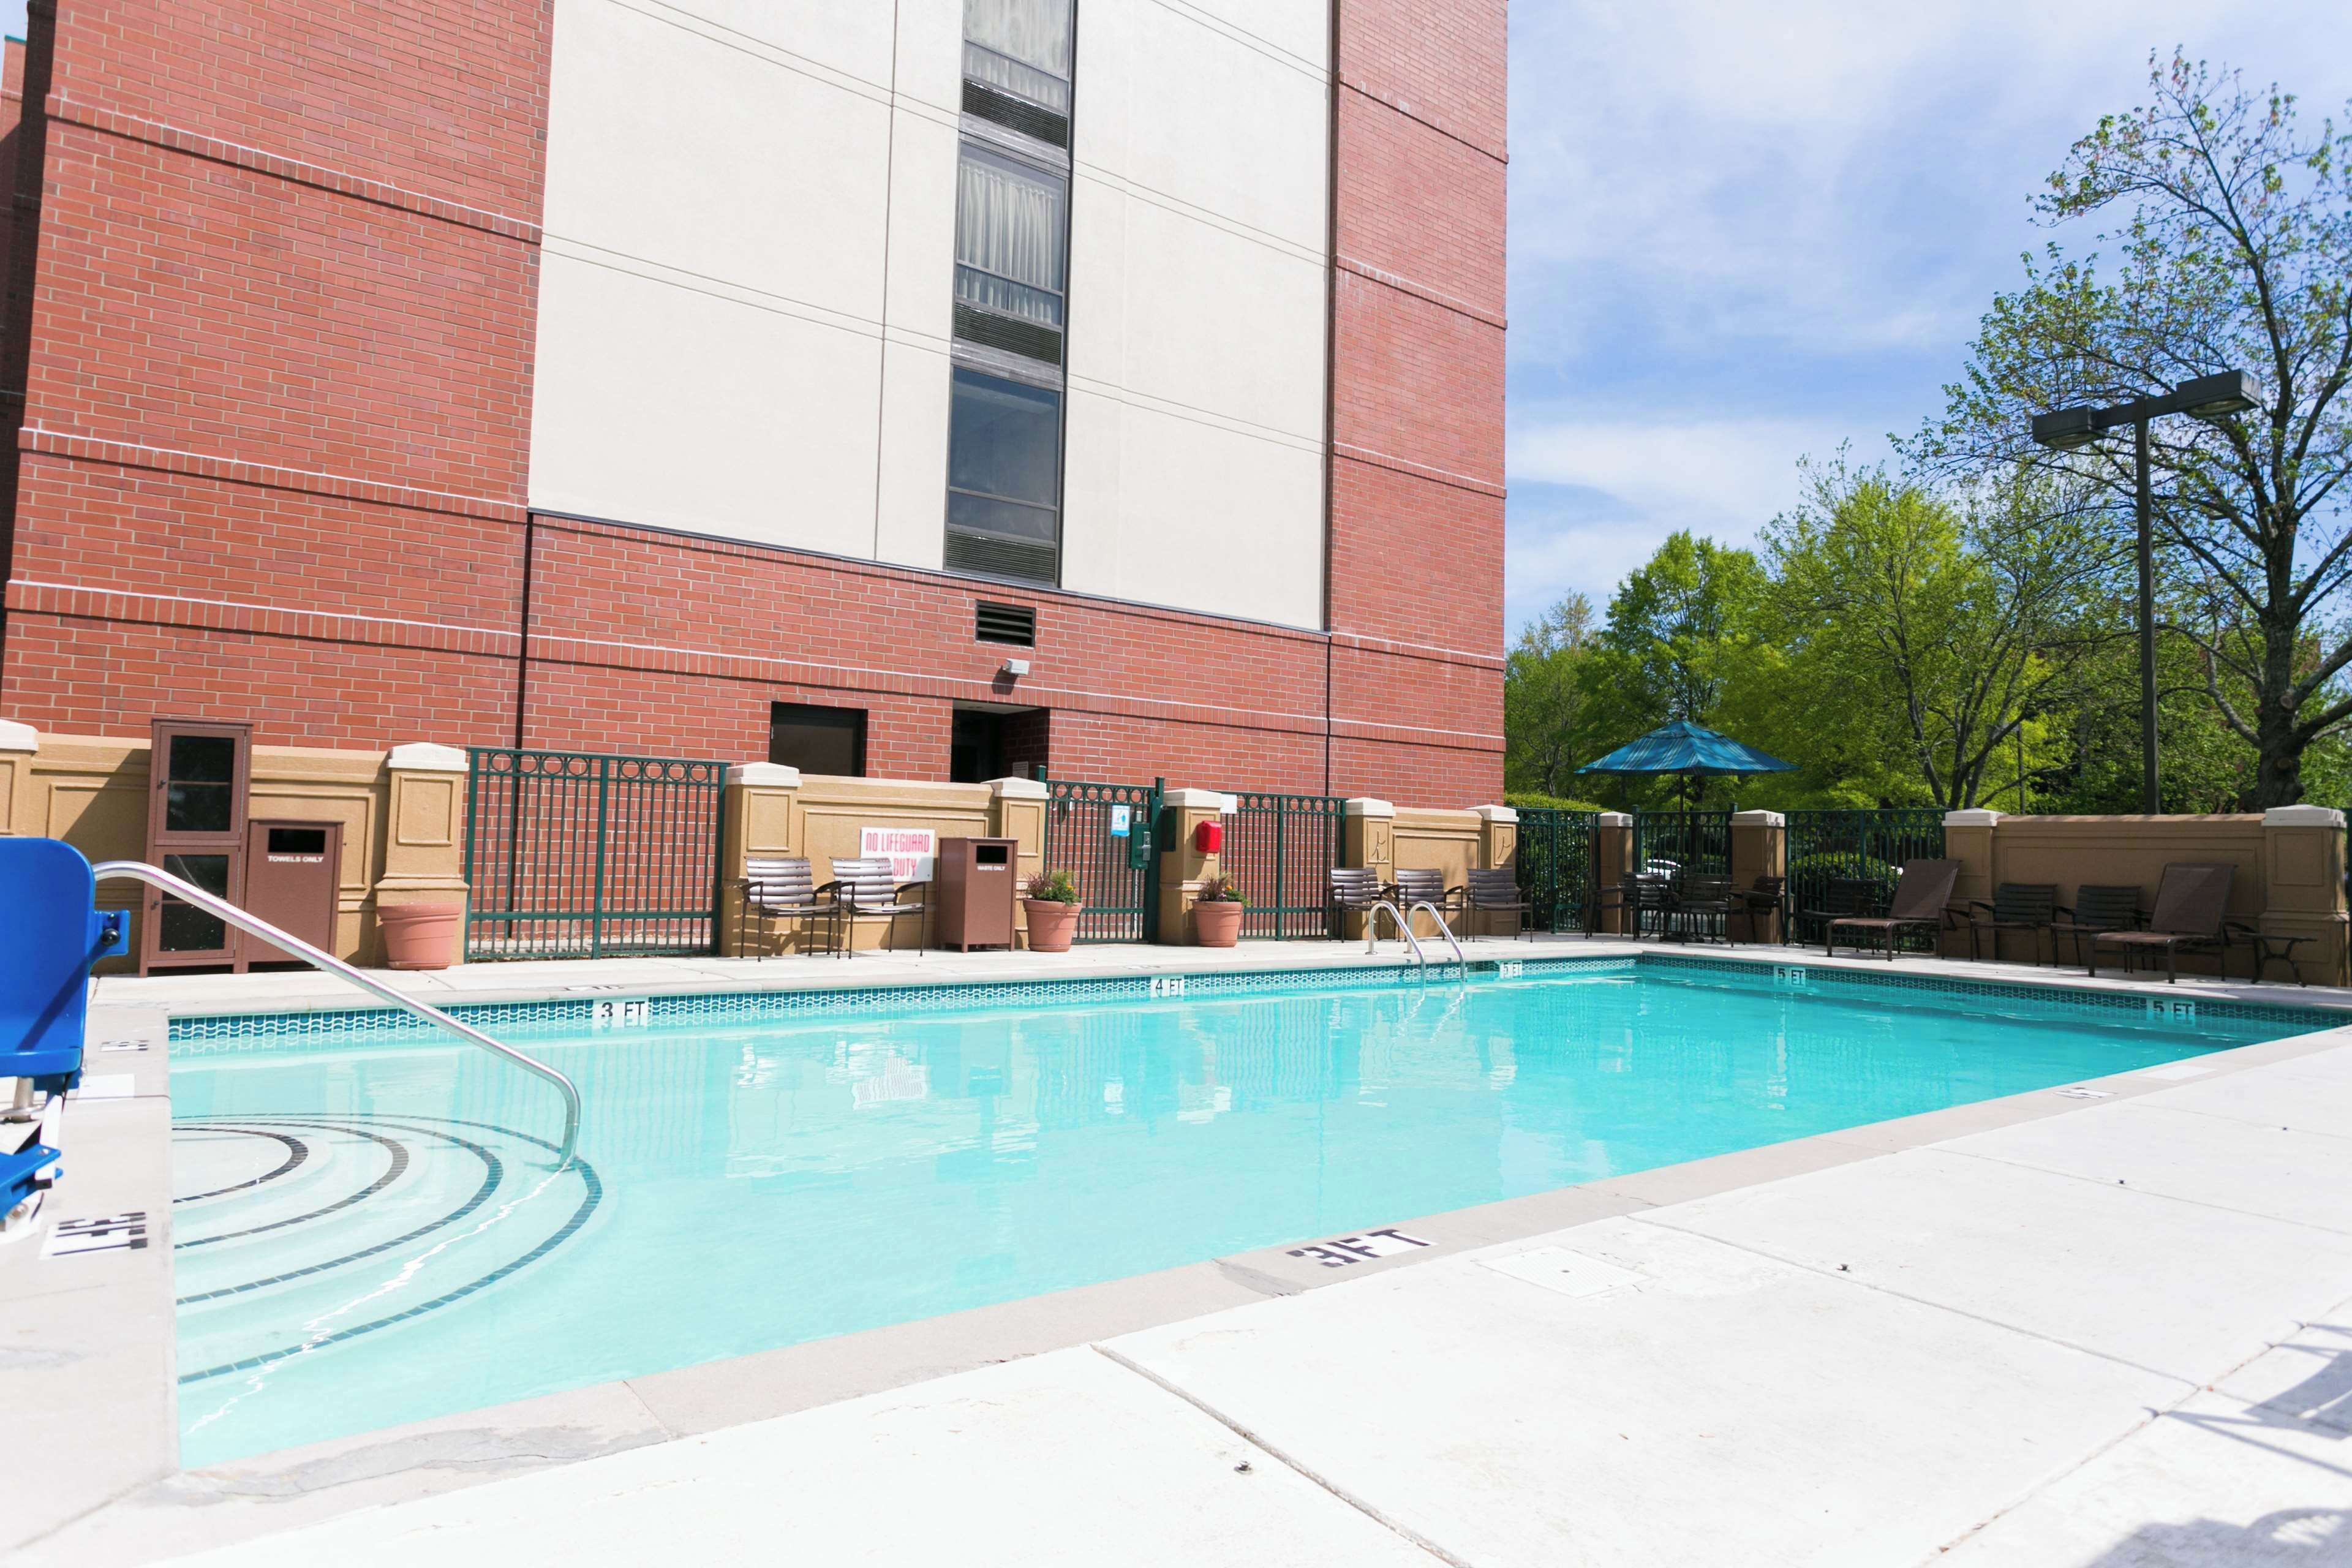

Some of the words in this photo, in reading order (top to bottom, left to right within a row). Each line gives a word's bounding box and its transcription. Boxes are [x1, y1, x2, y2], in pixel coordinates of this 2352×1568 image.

[865, 832, 878, 852] NO
[881, 833, 930, 853] LIFEGUARD
[892, 858, 917, 877] DUTY
[1777, 967, 1785, 978] 5
[1791, 969, 1804, 979] FT
[1155, 978, 1163, 990] 4
[1169, 978, 1182, 990] FT
[601, 1001, 613, 1017] 3
[624, 1001, 646, 1017] FT
[2153, 1000, 2164, 1012] 5
[2173, 1002, 2193, 1014] FT
